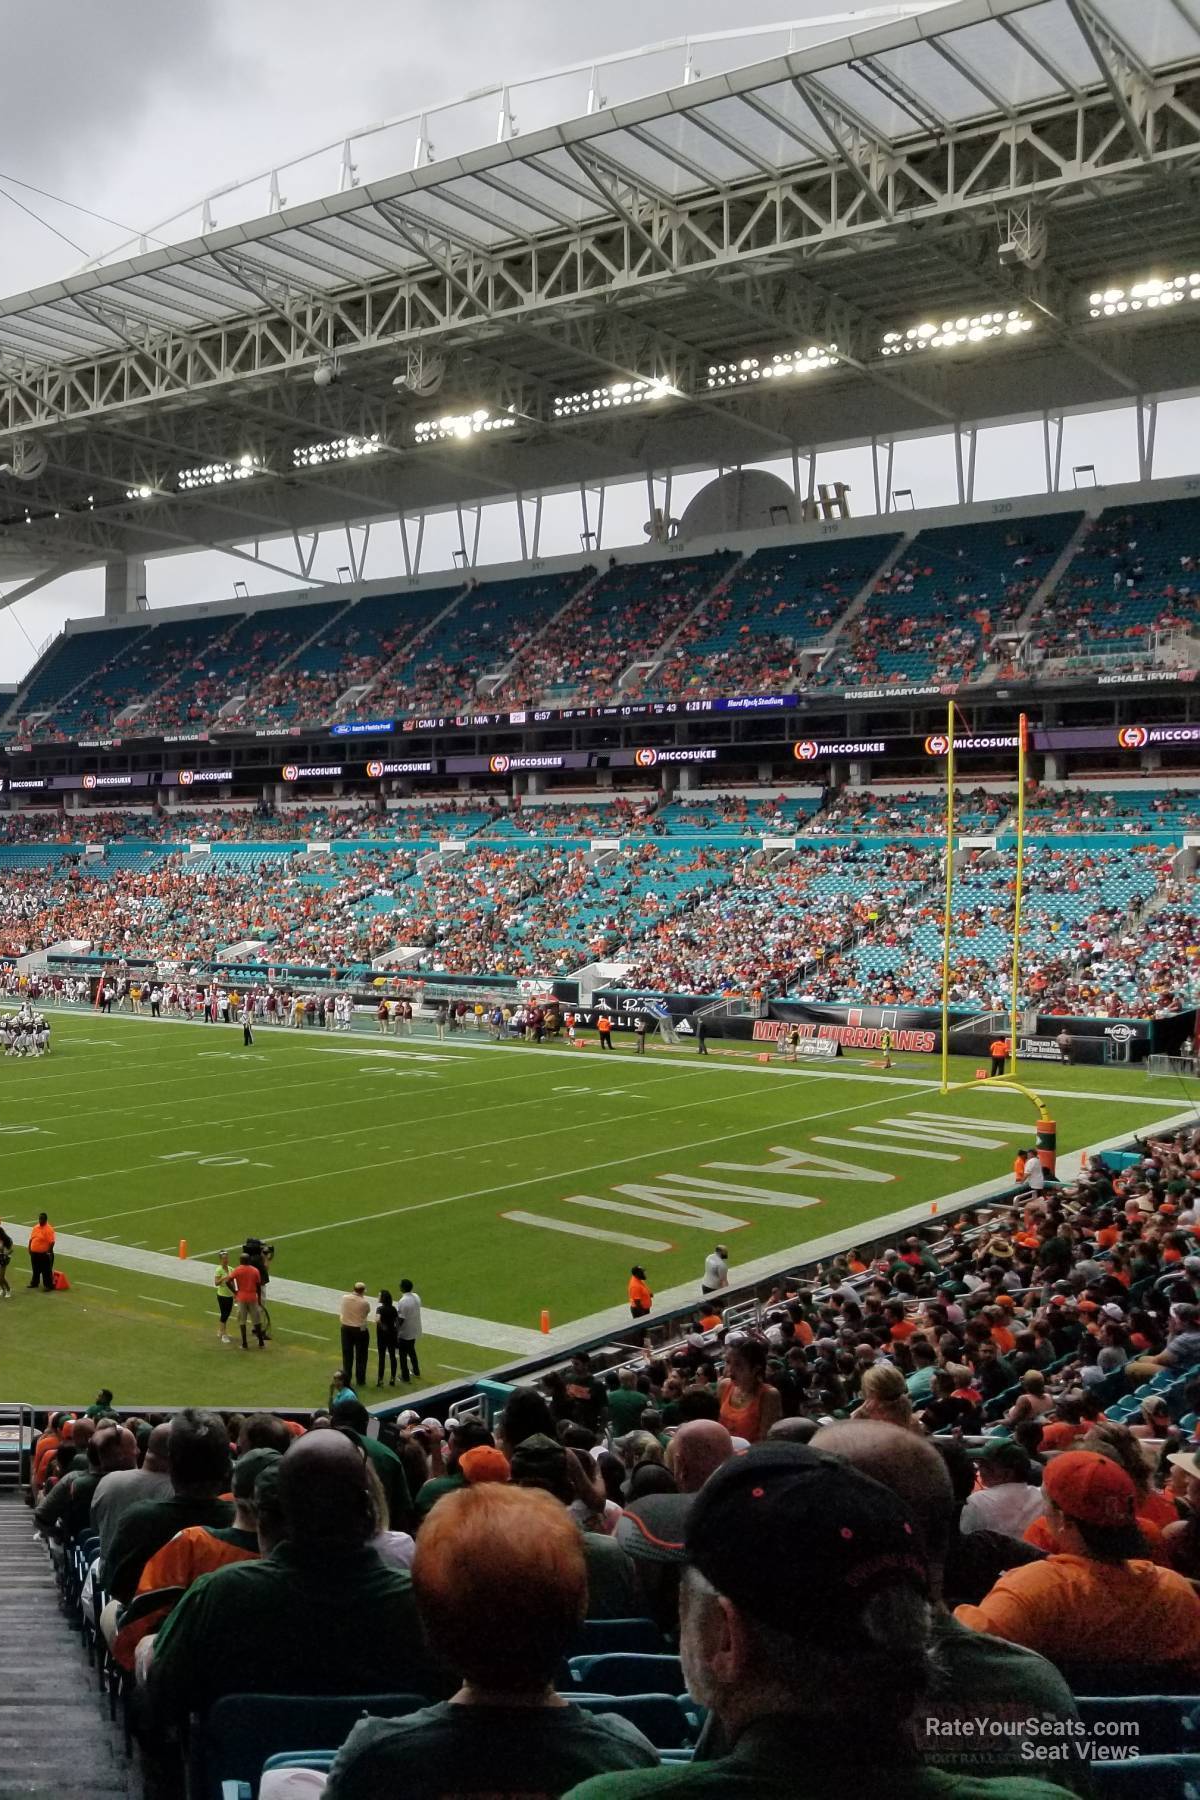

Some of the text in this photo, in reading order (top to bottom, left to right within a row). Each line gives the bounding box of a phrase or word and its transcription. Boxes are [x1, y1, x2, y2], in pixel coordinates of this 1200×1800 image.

[1098, 674, 1146, 684] MICHAEL
[1147, 672, 1177, 680] IRVIN
[844, 690, 884, 699] RUSSELL
[886, 686, 940, 697] MARYLAND
[702, 701, 712, 710] PM
[727, 697, 784, 707] Hard Rock Stadium
[621, 706, 631, 715] 10
[666, 703, 677, 712] 43
[474, 715, 500, 725] MIA 7
[534, 712, 551, 720] 6:57
[418, 719, 444, 728] CMU 0
[267, 728, 289, 736] DOOLEY
[1150, 730, 1200, 741] MICCOS
[820, 743, 885, 754] MICCOSUKEE
[658, 750, 717, 760] MICCOSUKEE
[510, 756, 562, 767] MICCOSUKEE
[299, 767, 342, 776] MICCOSUKEE
[384, 763, 431, 772] MICCOSUKEE
[194, 772, 232, 780] MICCOSUKEE
[150, 1150, 249, 1166] 10
[500, 1111, 1038, 1253] MIAMI
